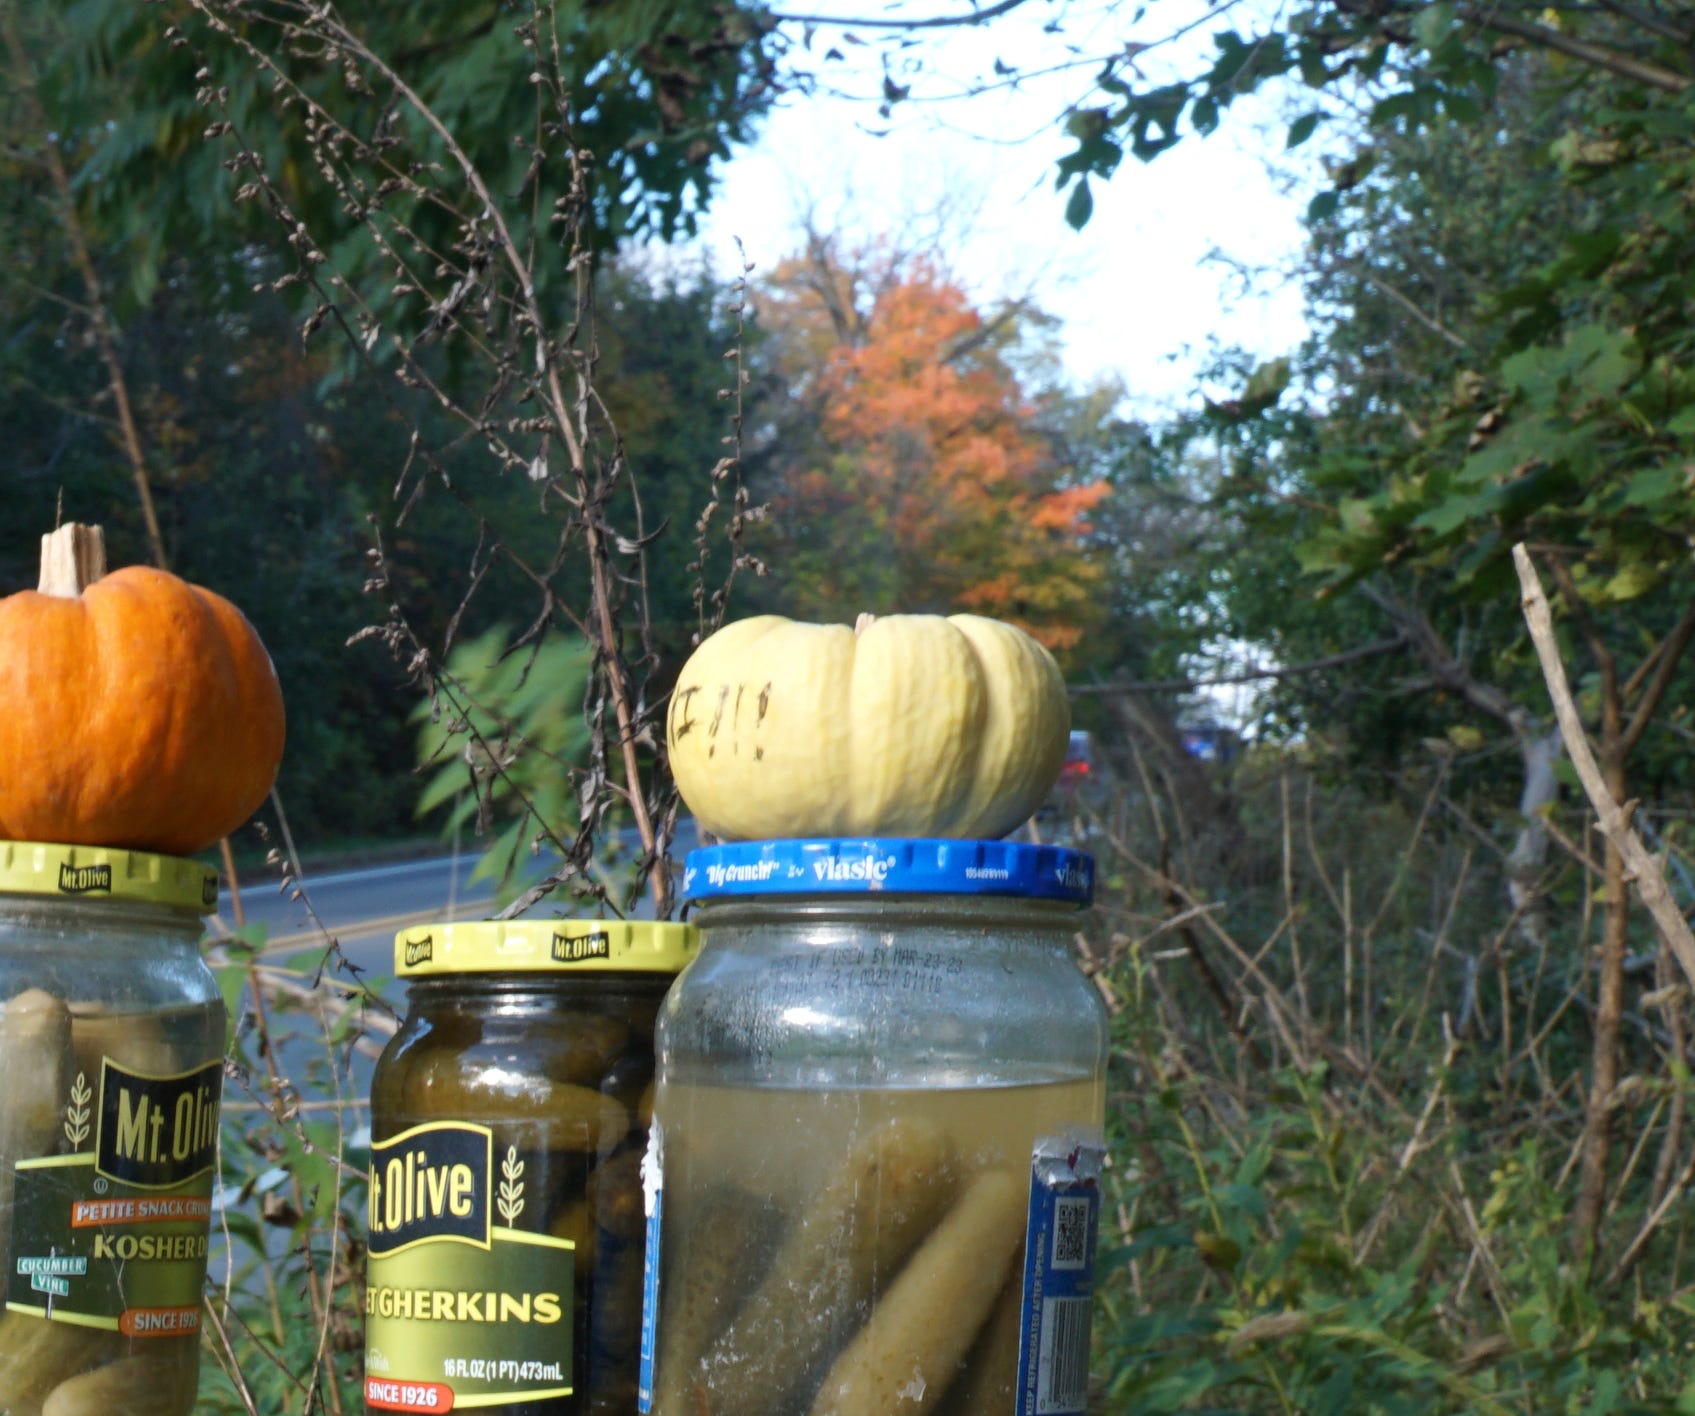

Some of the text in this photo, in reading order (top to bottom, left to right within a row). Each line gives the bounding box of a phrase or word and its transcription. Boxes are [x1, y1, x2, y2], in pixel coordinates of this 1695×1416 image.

[76, 1201, 134, 1222] PETITE
[137, 1199, 184, 1217] SNACK
[93, 1233, 196, 1261] KOSHER
[20, 1257, 84, 1273] CUCUMBER
[36, 1274, 66, 1293] VINE
[378, 1286, 563, 1325] GHERKINS
[133, 1312, 177, 1331] SINCE
[368, 1380, 438, 1407] SINCE 1926
[1025, 1388, 1035, 1416] KEEP
